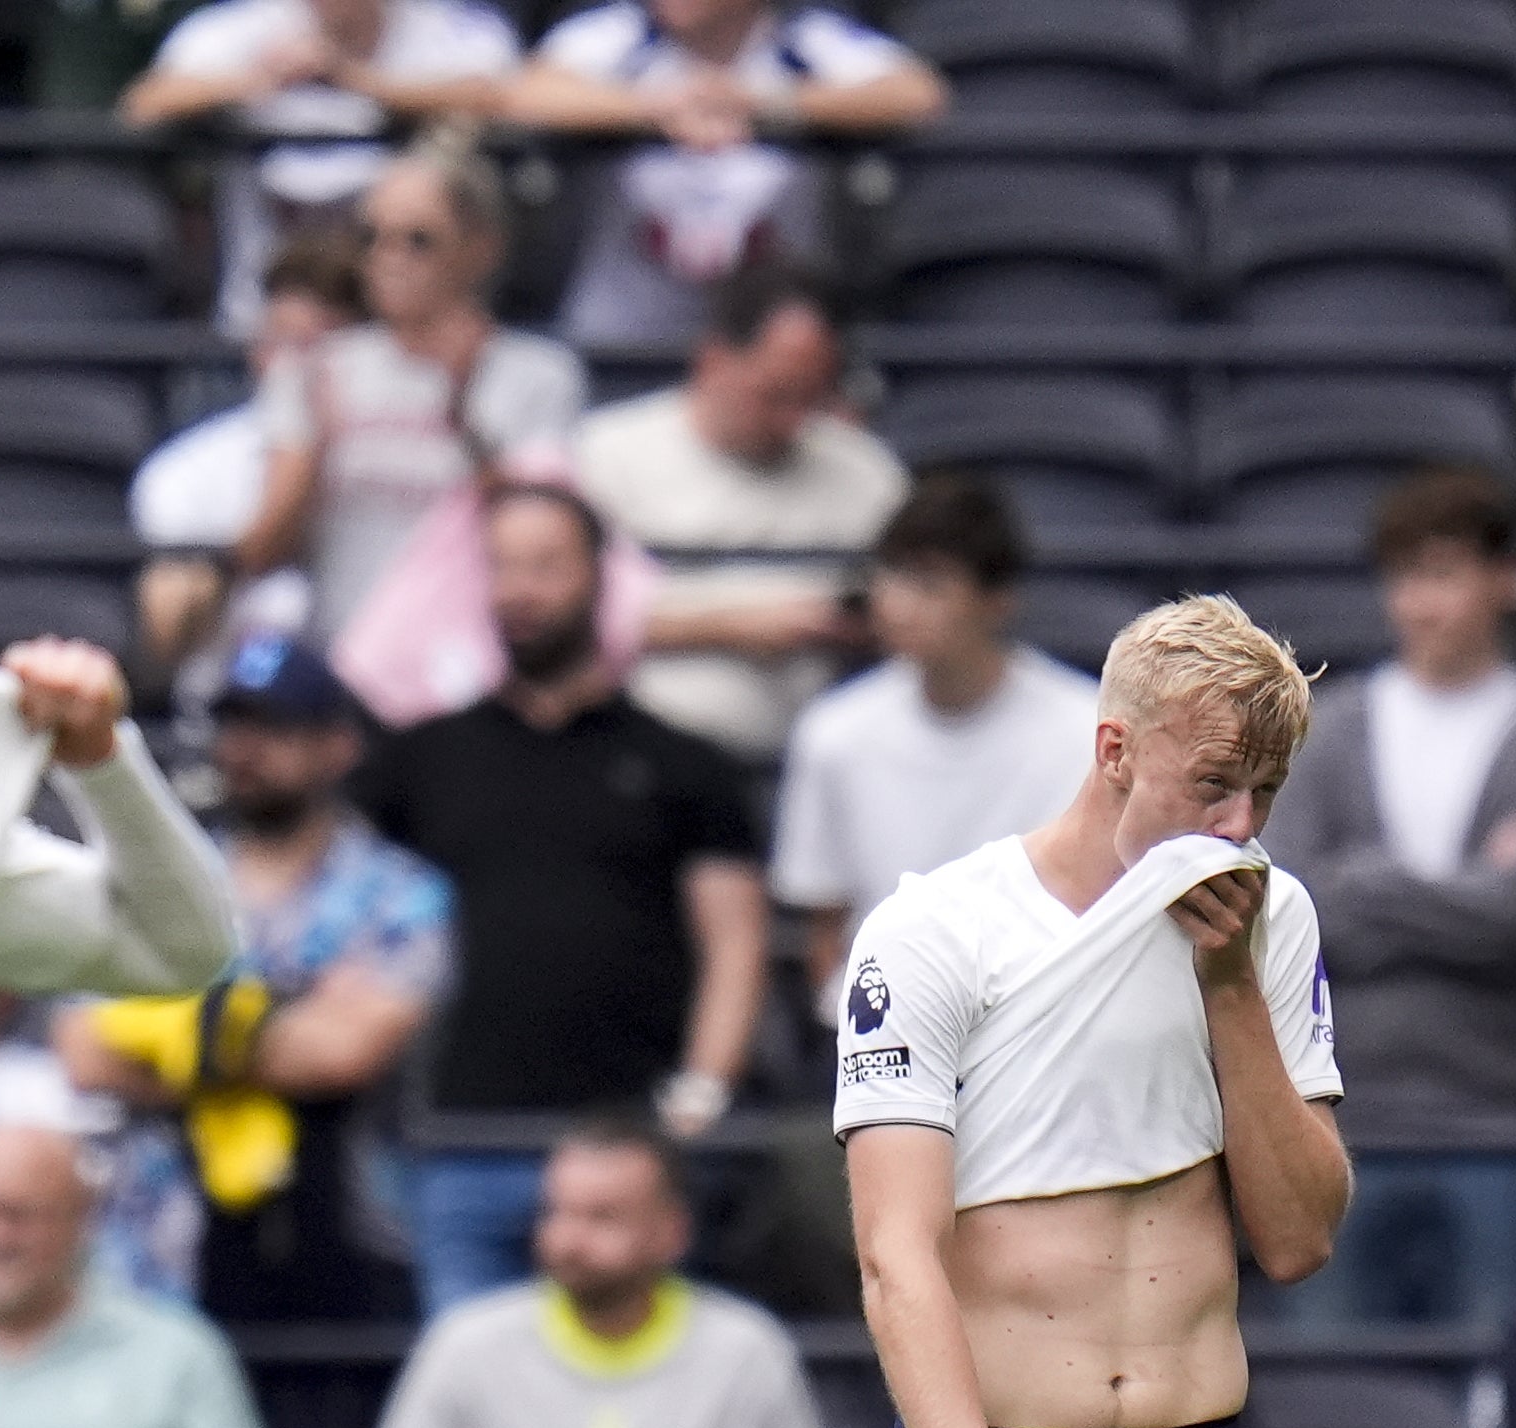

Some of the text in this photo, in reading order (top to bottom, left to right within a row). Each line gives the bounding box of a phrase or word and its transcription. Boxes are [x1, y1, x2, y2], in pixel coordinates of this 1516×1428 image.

[841, 1050, 902, 1074] No room
[858, 1064, 912, 1082] racism
